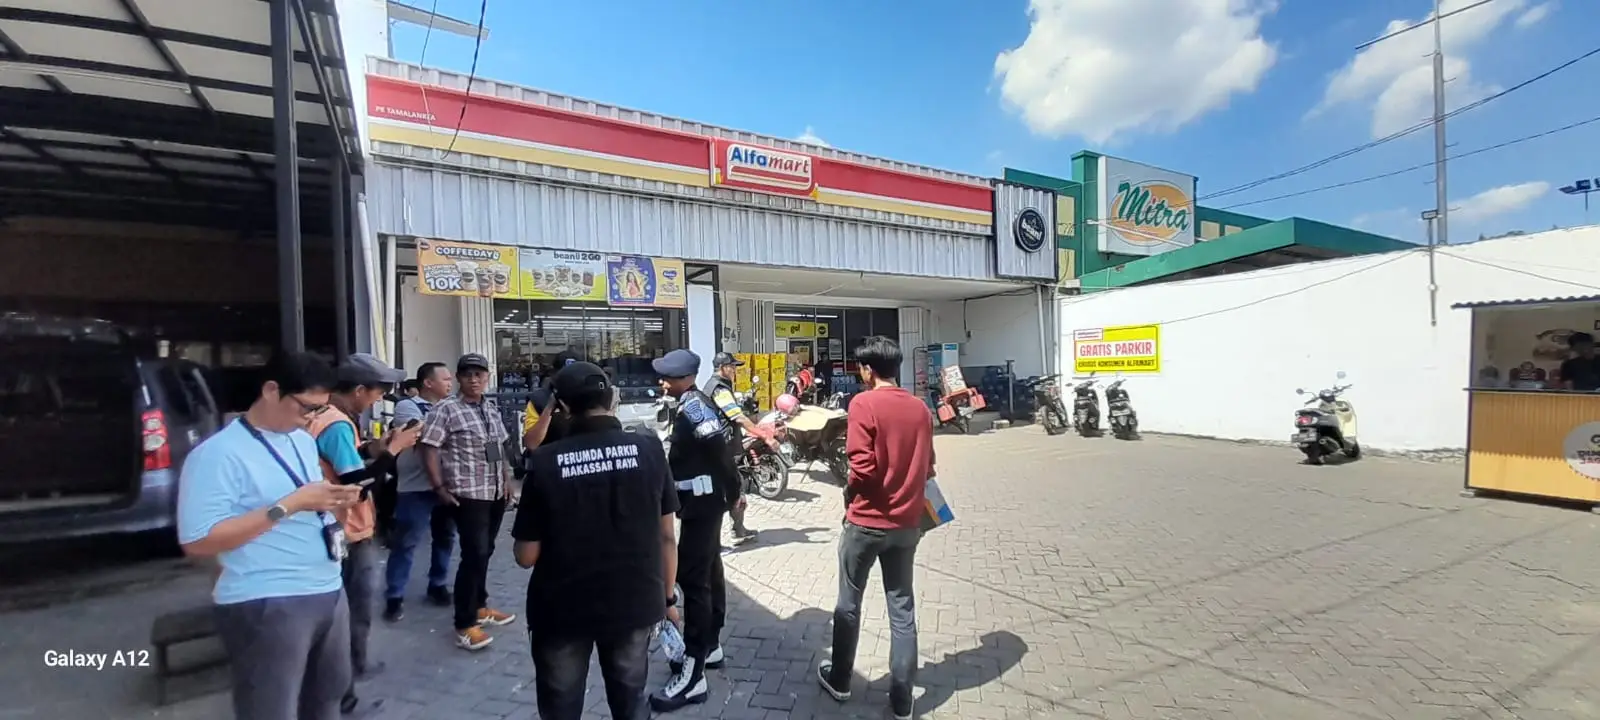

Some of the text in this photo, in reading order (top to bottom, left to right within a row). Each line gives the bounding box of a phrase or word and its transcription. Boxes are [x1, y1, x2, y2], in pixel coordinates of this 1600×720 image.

[731, 146, 809, 173] Alfamart
[1118, 182, 1189, 231] Mitra
[426, 277, 461, 291] 10K
[1080, 342, 1152, 356] GRATIS PARKIR
[557, 444, 639, 466] PERUMDA PARKIR
[561, 457, 638, 478] MAKASSAR RAYA
